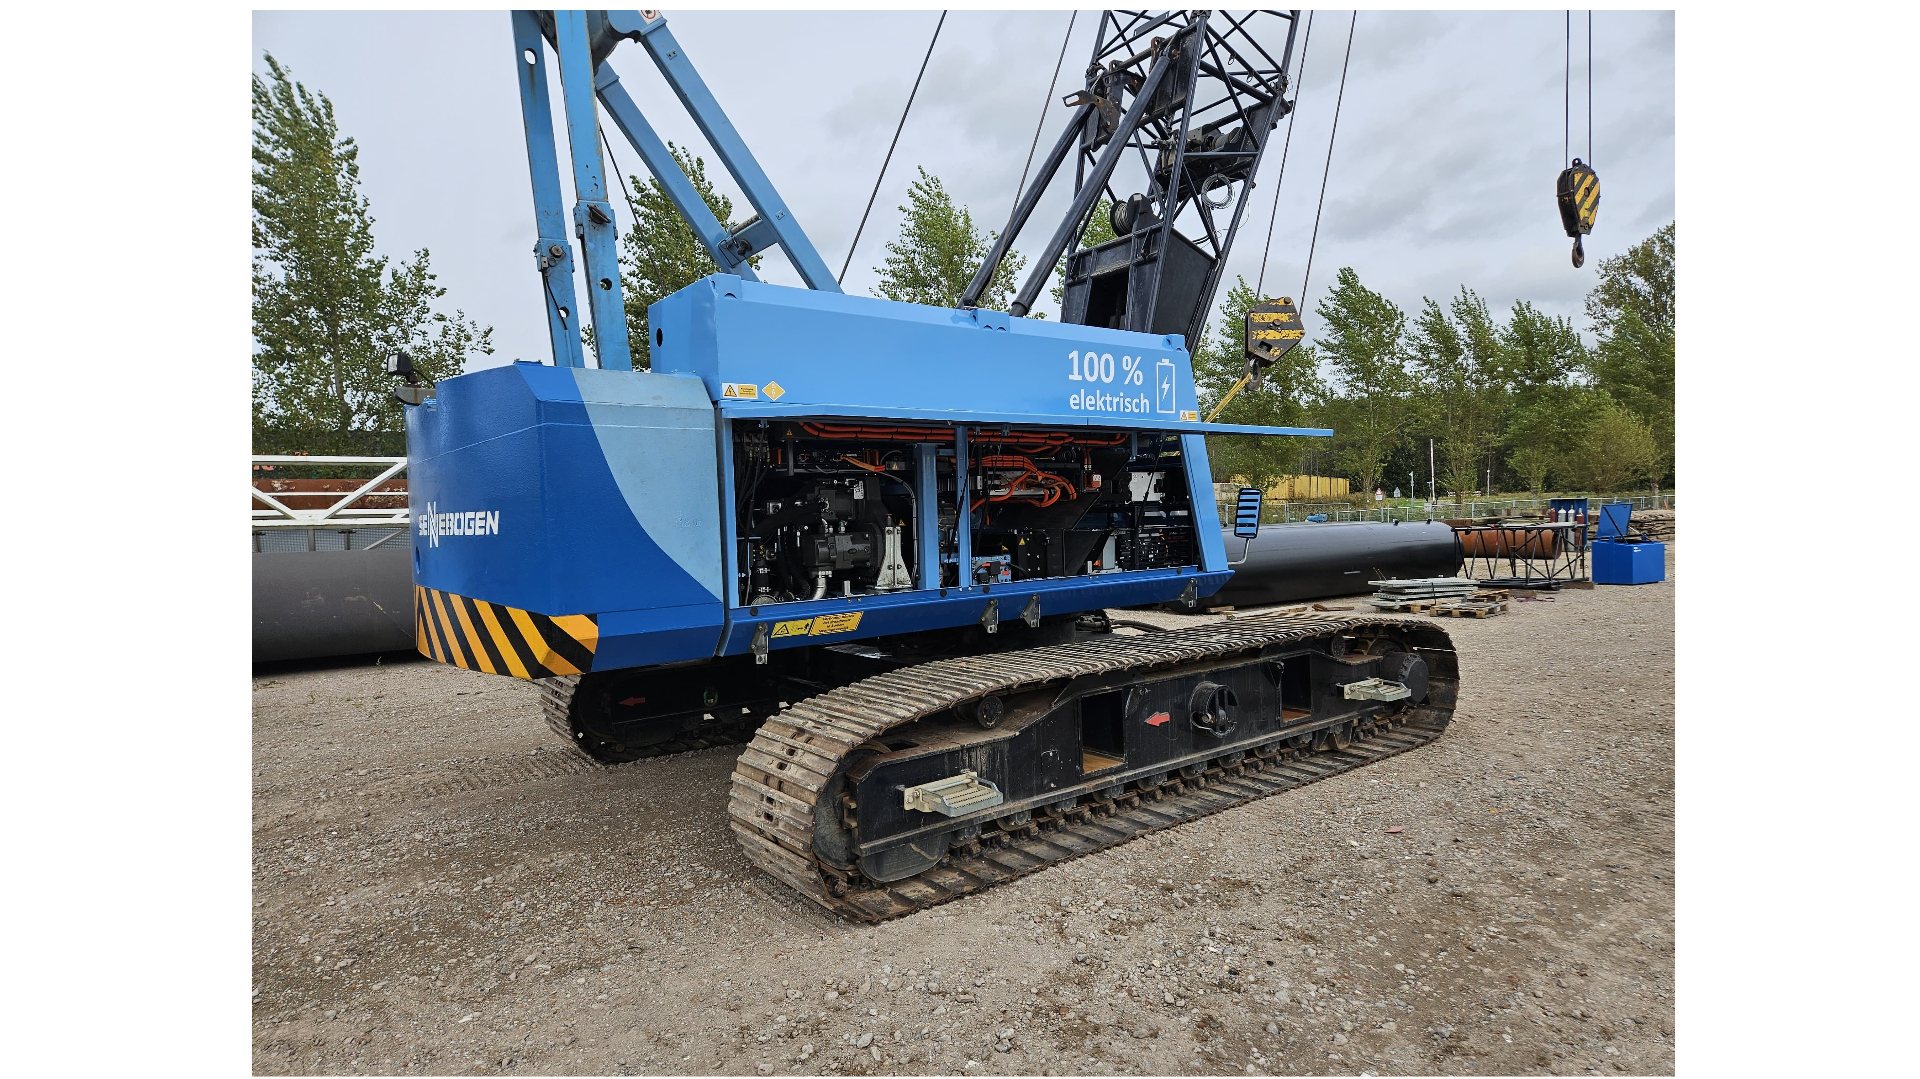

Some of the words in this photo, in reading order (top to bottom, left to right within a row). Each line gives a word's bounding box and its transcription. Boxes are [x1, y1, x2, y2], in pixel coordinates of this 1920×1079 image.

[1068, 350, 1115, 384] 100
[1122, 355, 1144, 386] %
[1069, 388, 1150, 414] elektrisch
